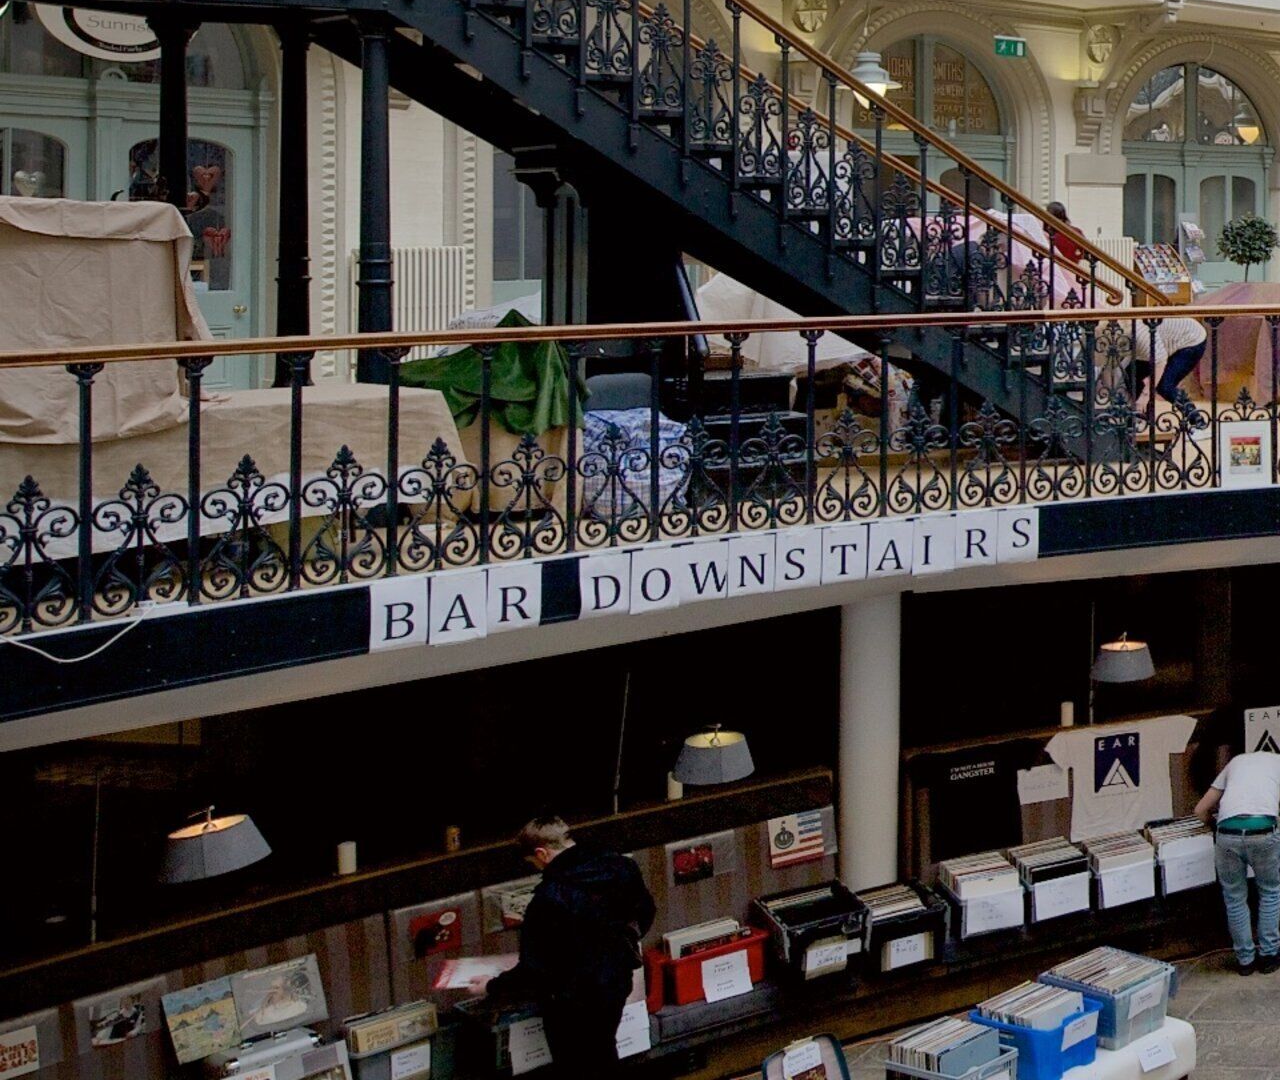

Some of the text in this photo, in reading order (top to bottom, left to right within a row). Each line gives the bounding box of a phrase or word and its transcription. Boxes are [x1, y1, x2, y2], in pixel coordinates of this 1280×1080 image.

[87, 15, 152, 33] Sunris
[383, 518, 1031, 641] BAR DOWNSTAIRS
[1098, 735, 1137, 752] EAR
[950, 767, 996, 781] GANGSTER
